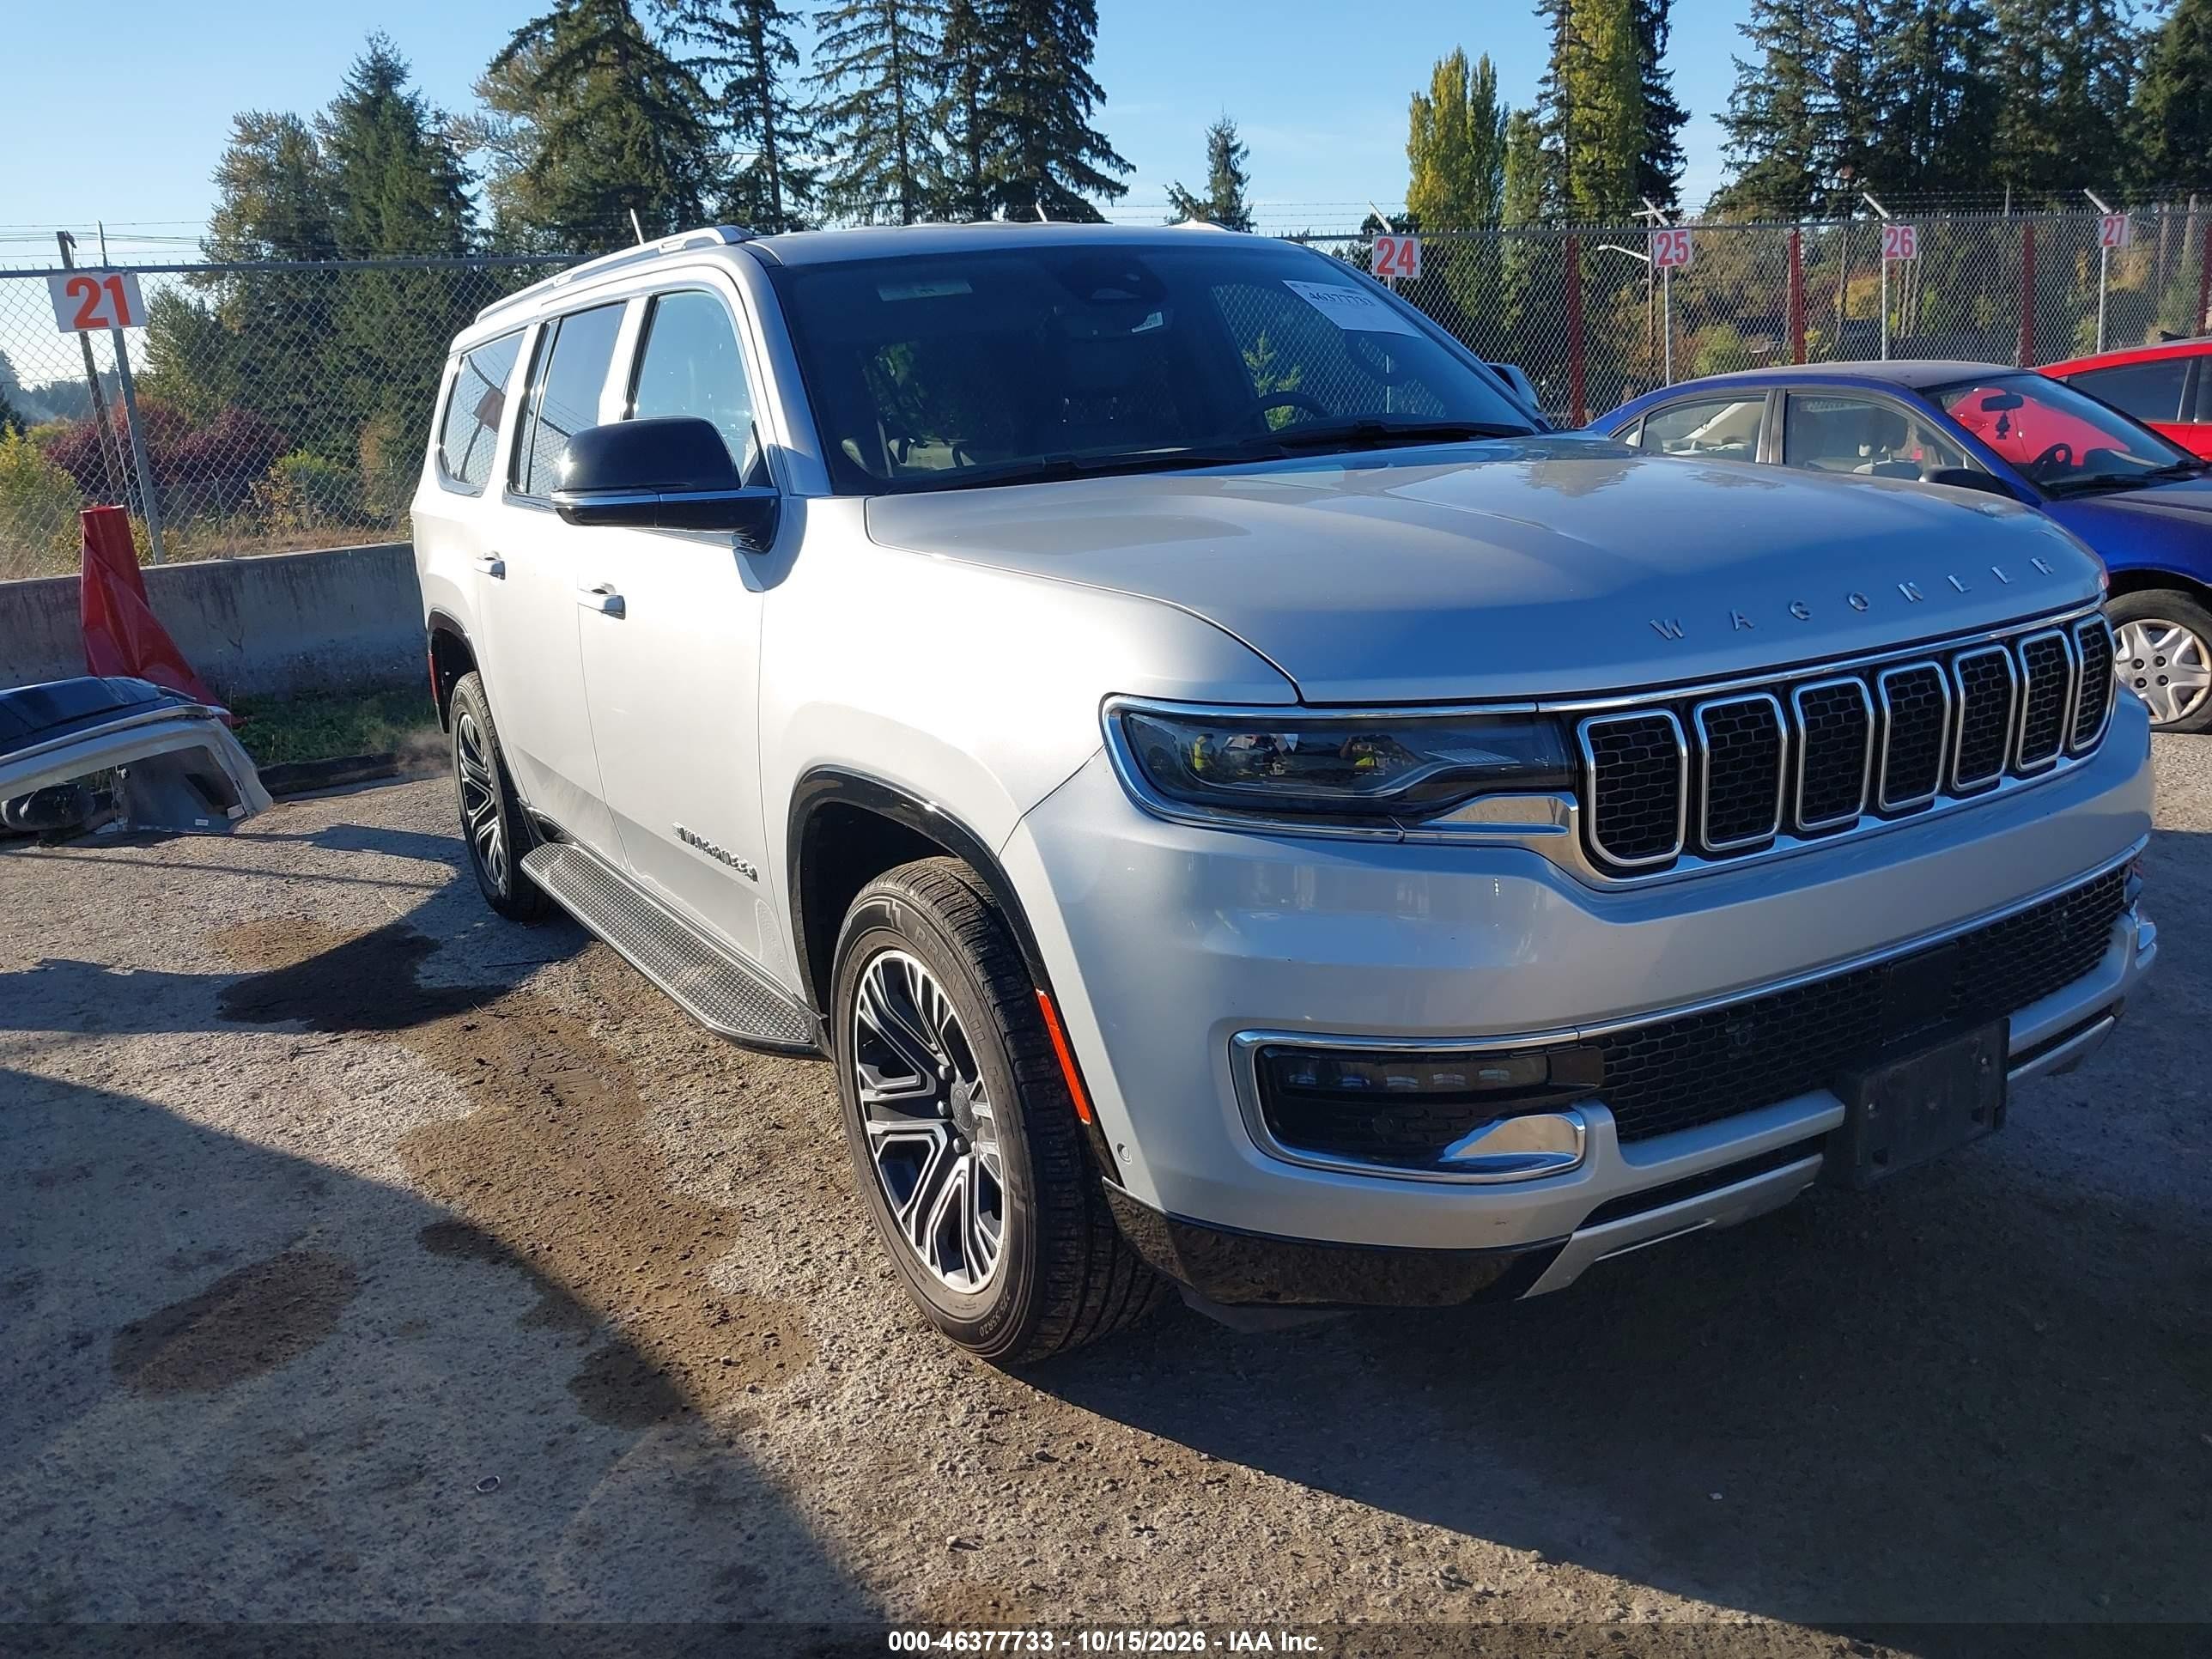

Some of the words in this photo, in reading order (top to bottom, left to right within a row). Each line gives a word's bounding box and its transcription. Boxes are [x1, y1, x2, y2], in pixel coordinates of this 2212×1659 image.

[1657, 230, 1689, 266] 25
[1885, 228, 1914, 258] 26
[2103, 216, 2126, 246] 27
[1376, 237, 1417, 276] 24
[66, 276, 131, 329] 21
[1649, 556, 2056, 641] WAGONEER
